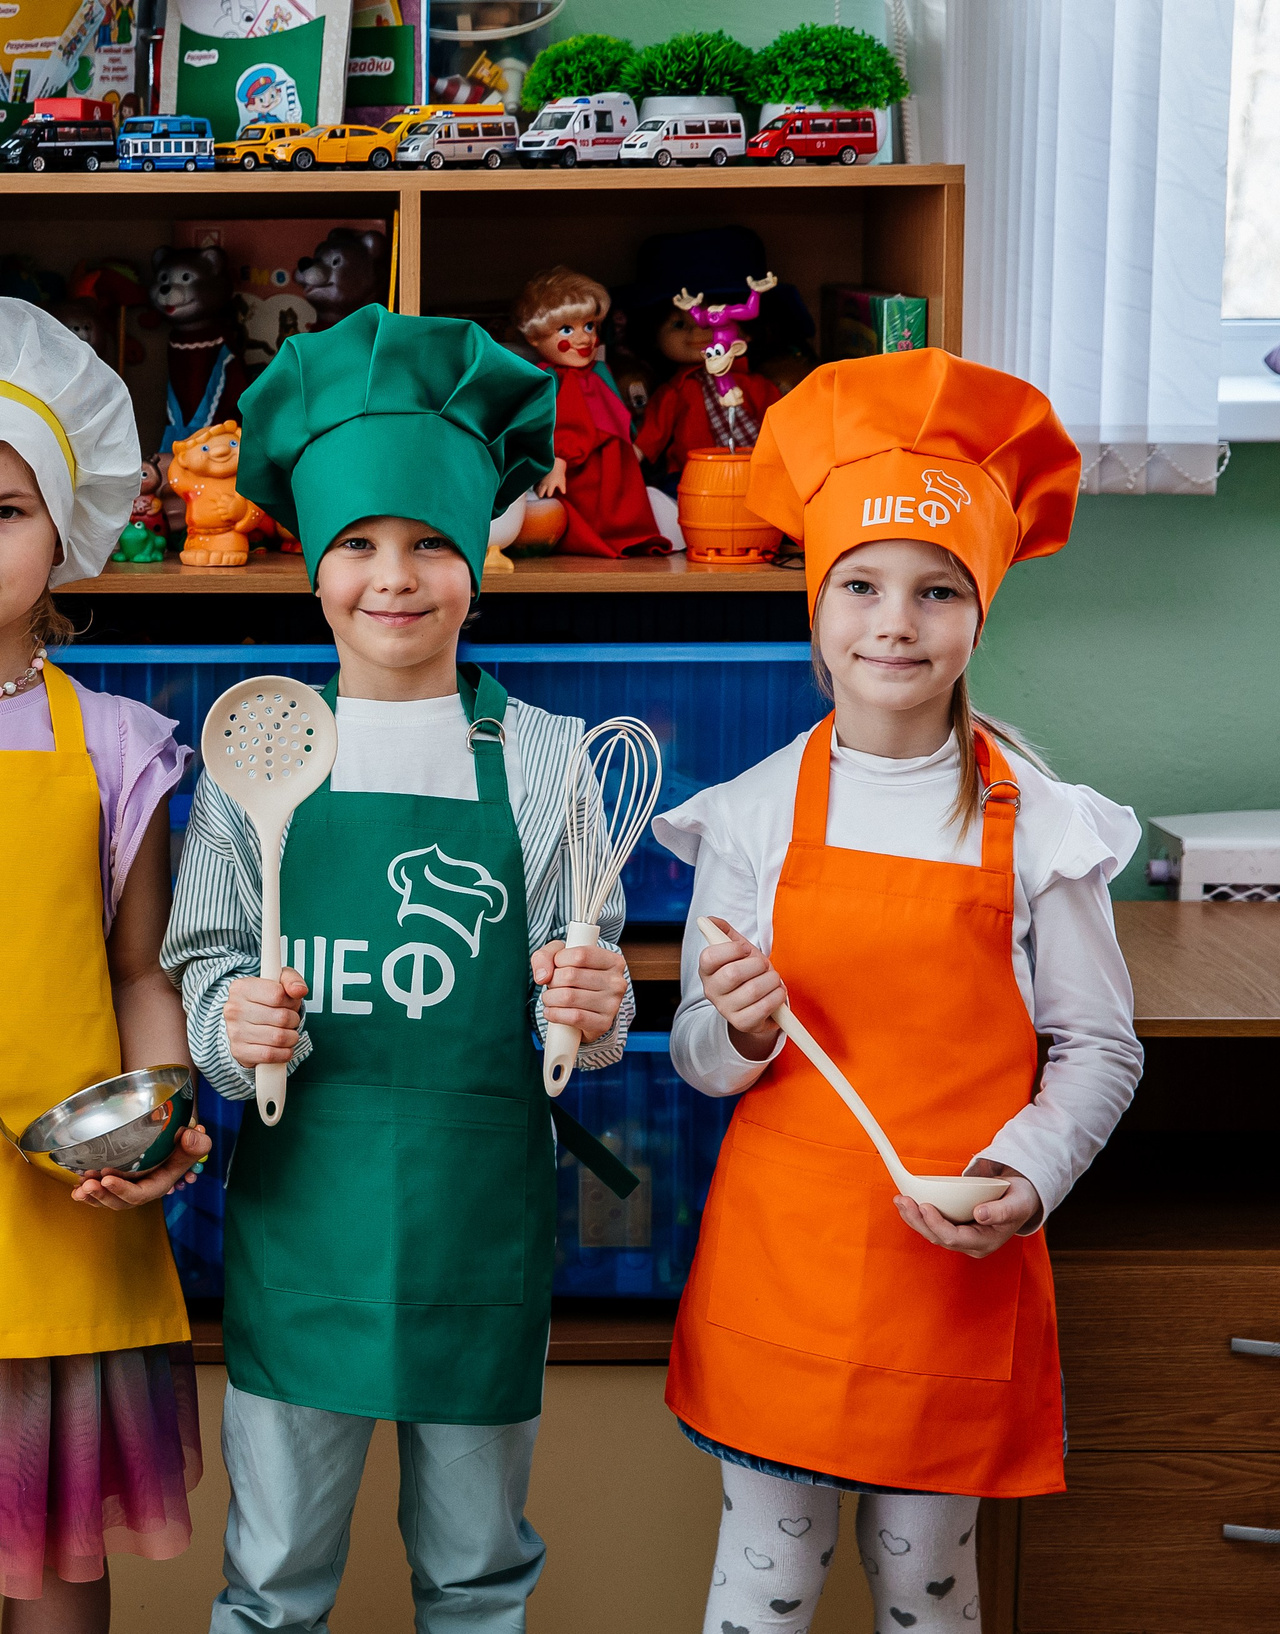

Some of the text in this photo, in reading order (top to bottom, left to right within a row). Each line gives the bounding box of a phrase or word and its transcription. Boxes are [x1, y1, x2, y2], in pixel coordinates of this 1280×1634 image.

[690, 142, 699, 150] 03
[816, 140, 826, 149] 01
[63, 148, 73, 157] 02
[861, 495, 951, 528] ШЕФ
